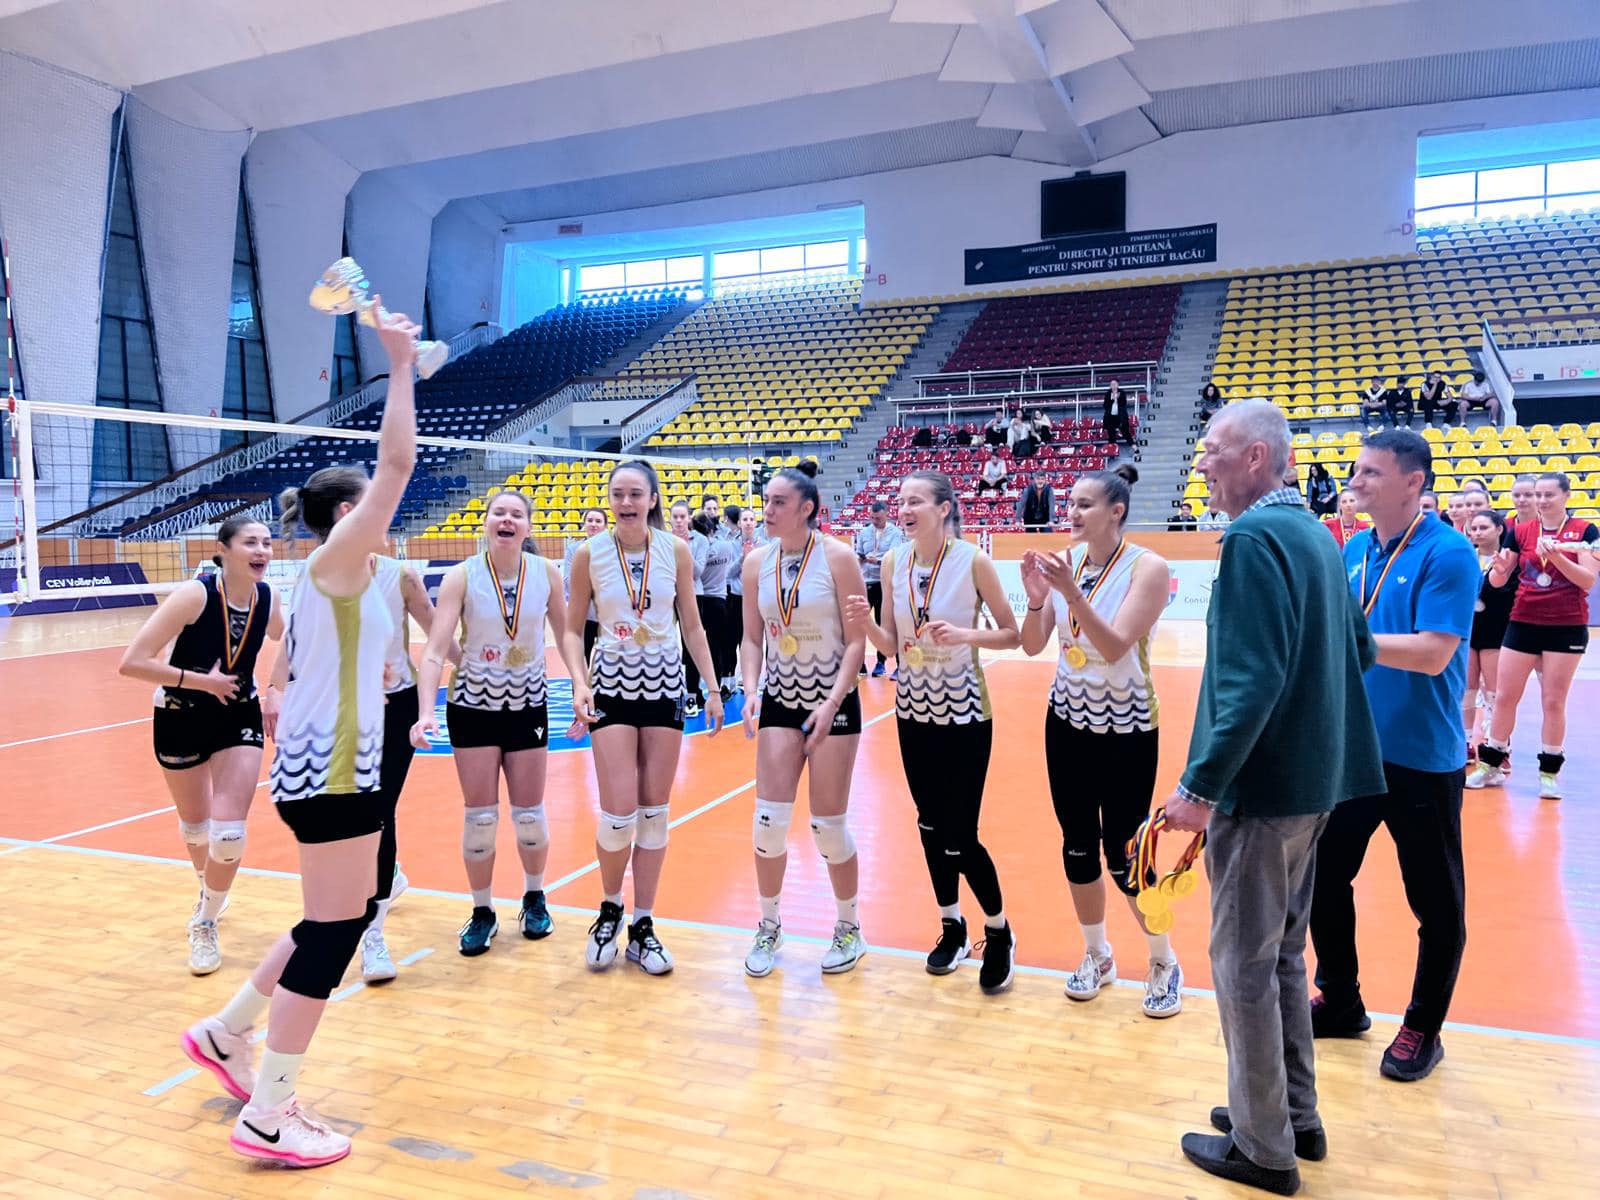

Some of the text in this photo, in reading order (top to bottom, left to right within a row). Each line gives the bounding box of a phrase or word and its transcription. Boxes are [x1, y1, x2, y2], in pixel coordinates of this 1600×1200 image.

[1402, 223, 1413, 236] D
[1028, 263, 1069, 275] PENTRU
[1071, 259, 1106, 271] SPORT
[1121, 253, 1168, 266] TINERET
[1169, 248, 1206, 261] BACĂU
[878, 273, 887, 286] B
[319, 369, 329, 381] A
[46, 575, 112, 588] CEV Volleyball
